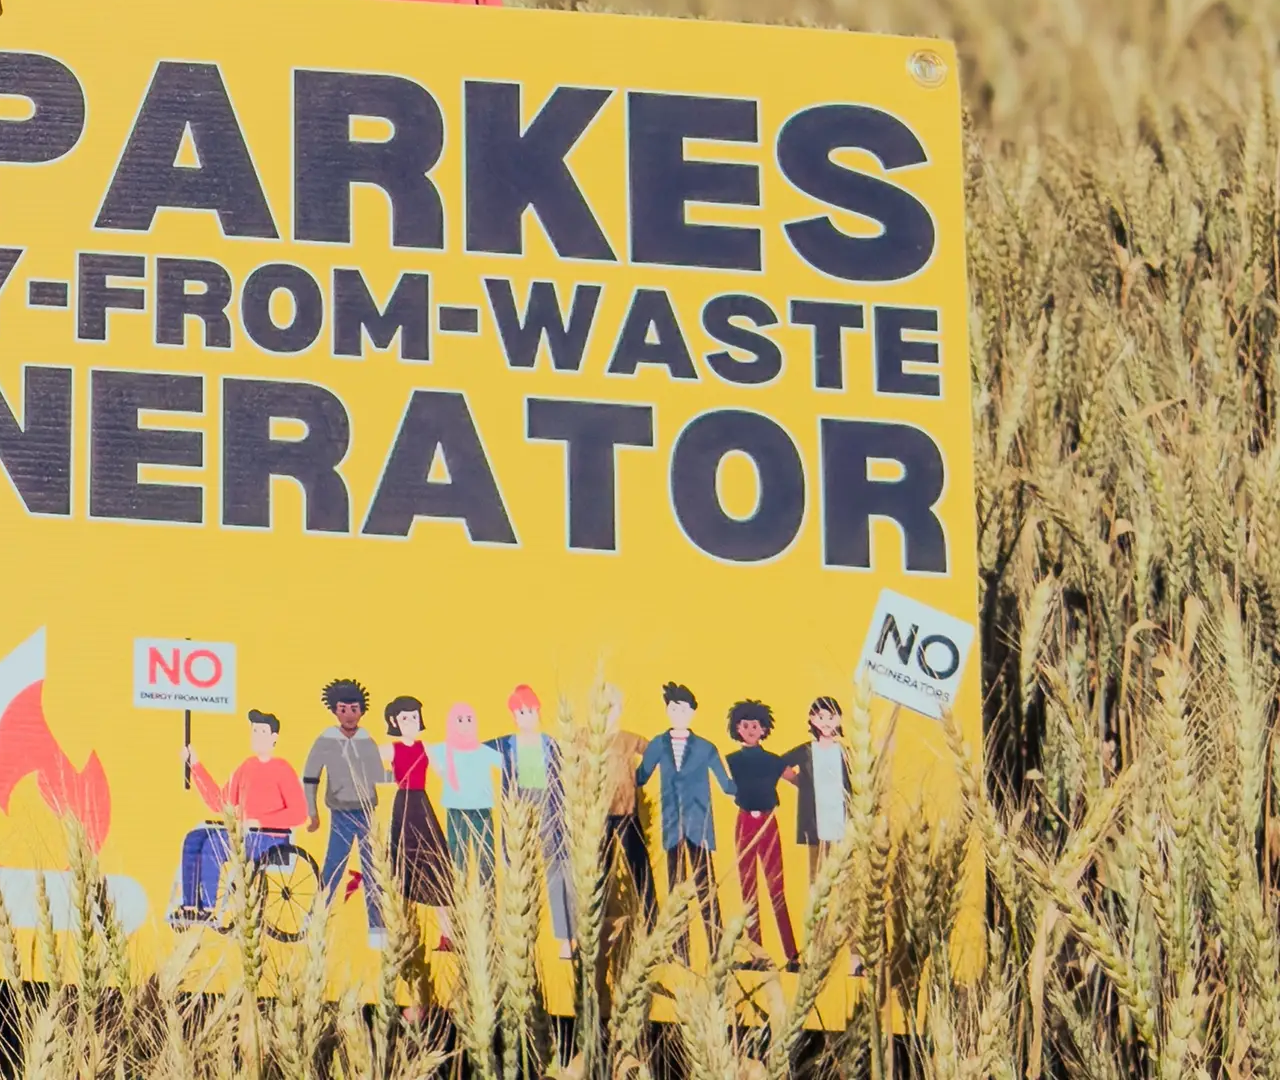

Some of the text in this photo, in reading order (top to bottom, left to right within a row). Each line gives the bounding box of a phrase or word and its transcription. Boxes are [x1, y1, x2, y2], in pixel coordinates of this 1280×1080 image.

[147, 646, 223, 689] NO
[874, 612, 960, 680] NO
[140, 691, 229, 705] ENERGY FROM WASTE
[864, 659, 951, 703] INCINERATORS
